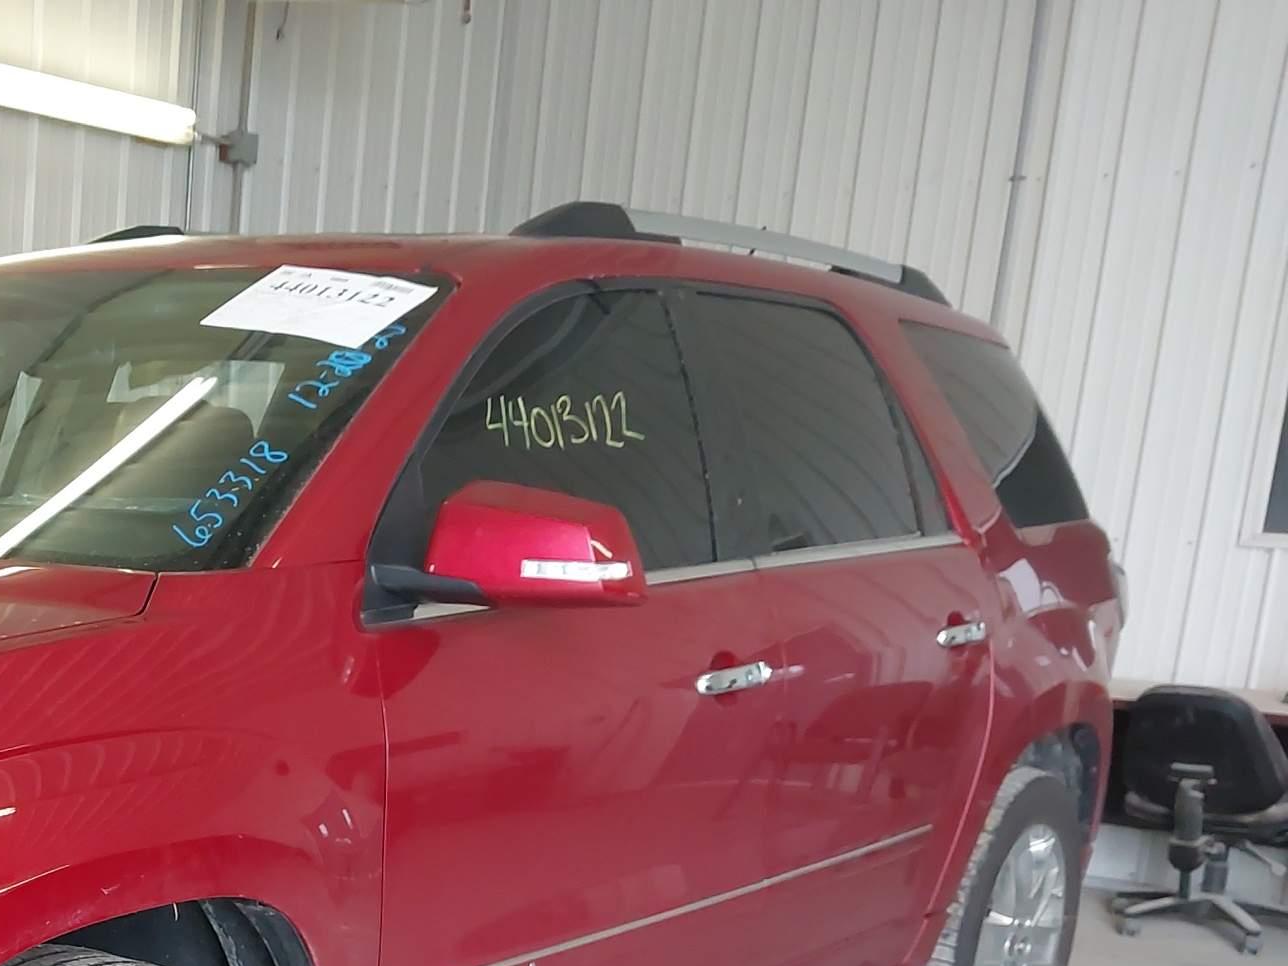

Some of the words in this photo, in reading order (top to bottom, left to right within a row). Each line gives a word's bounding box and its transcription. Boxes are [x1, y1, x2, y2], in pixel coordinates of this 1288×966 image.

[271, 279, 396, 308] 44013122
[486, 391, 646, 450] 44013122
[173, 440, 289, 547] 653318
